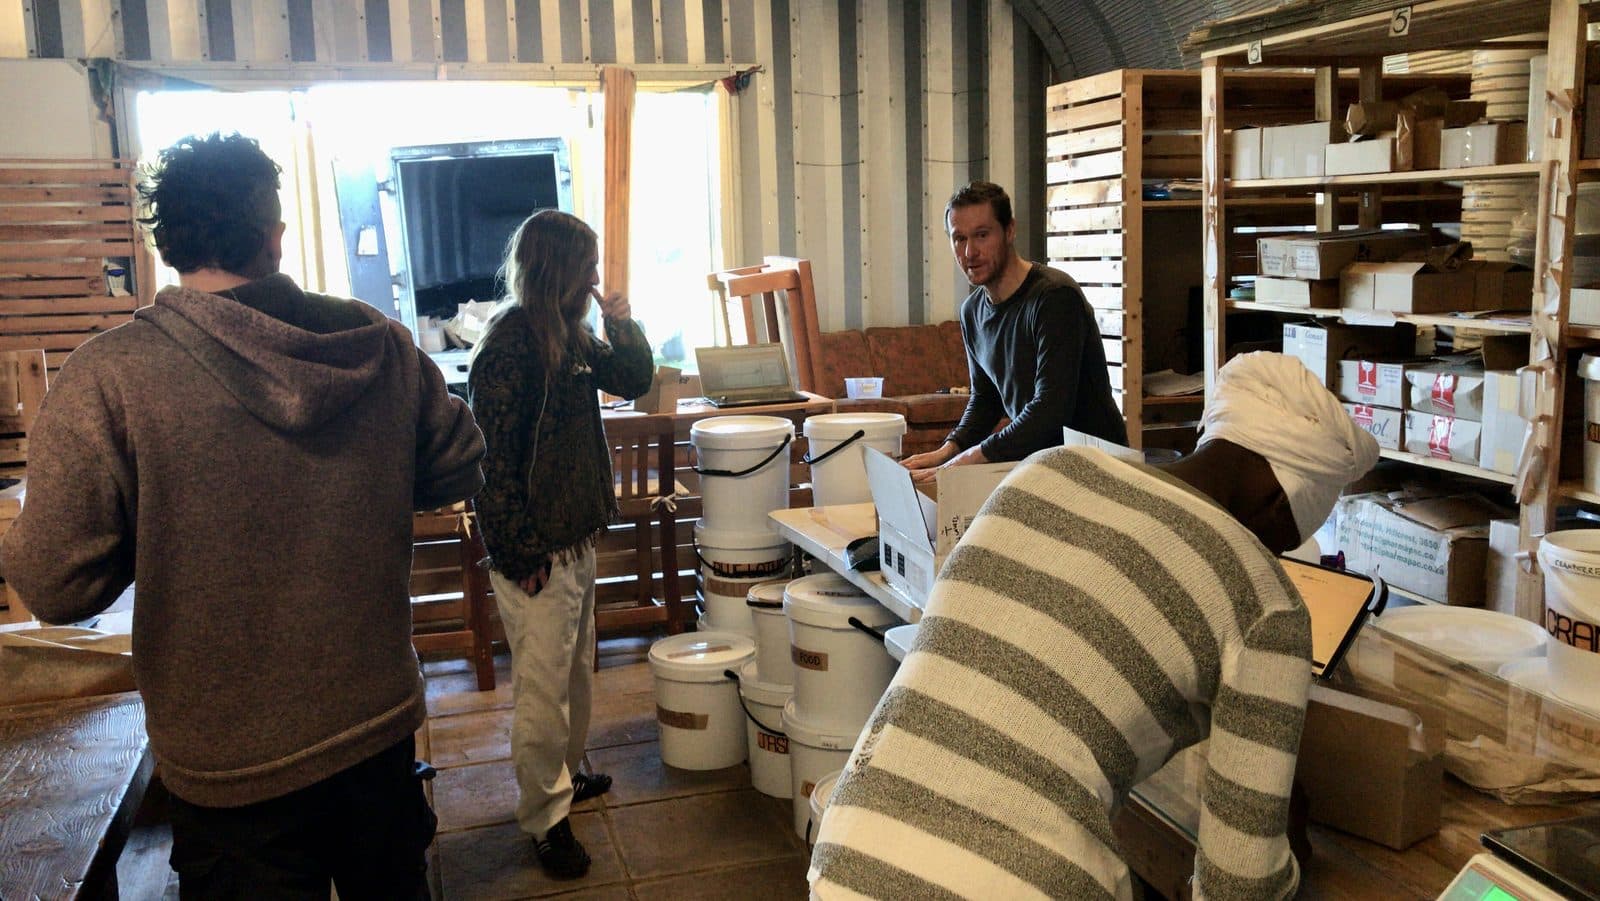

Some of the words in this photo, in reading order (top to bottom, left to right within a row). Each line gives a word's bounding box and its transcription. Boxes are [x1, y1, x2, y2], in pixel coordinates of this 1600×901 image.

[1392, 9, 1408, 34] 5
[799, 652, 821, 667] FOOD
[757, 731, 789, 754] JAS
